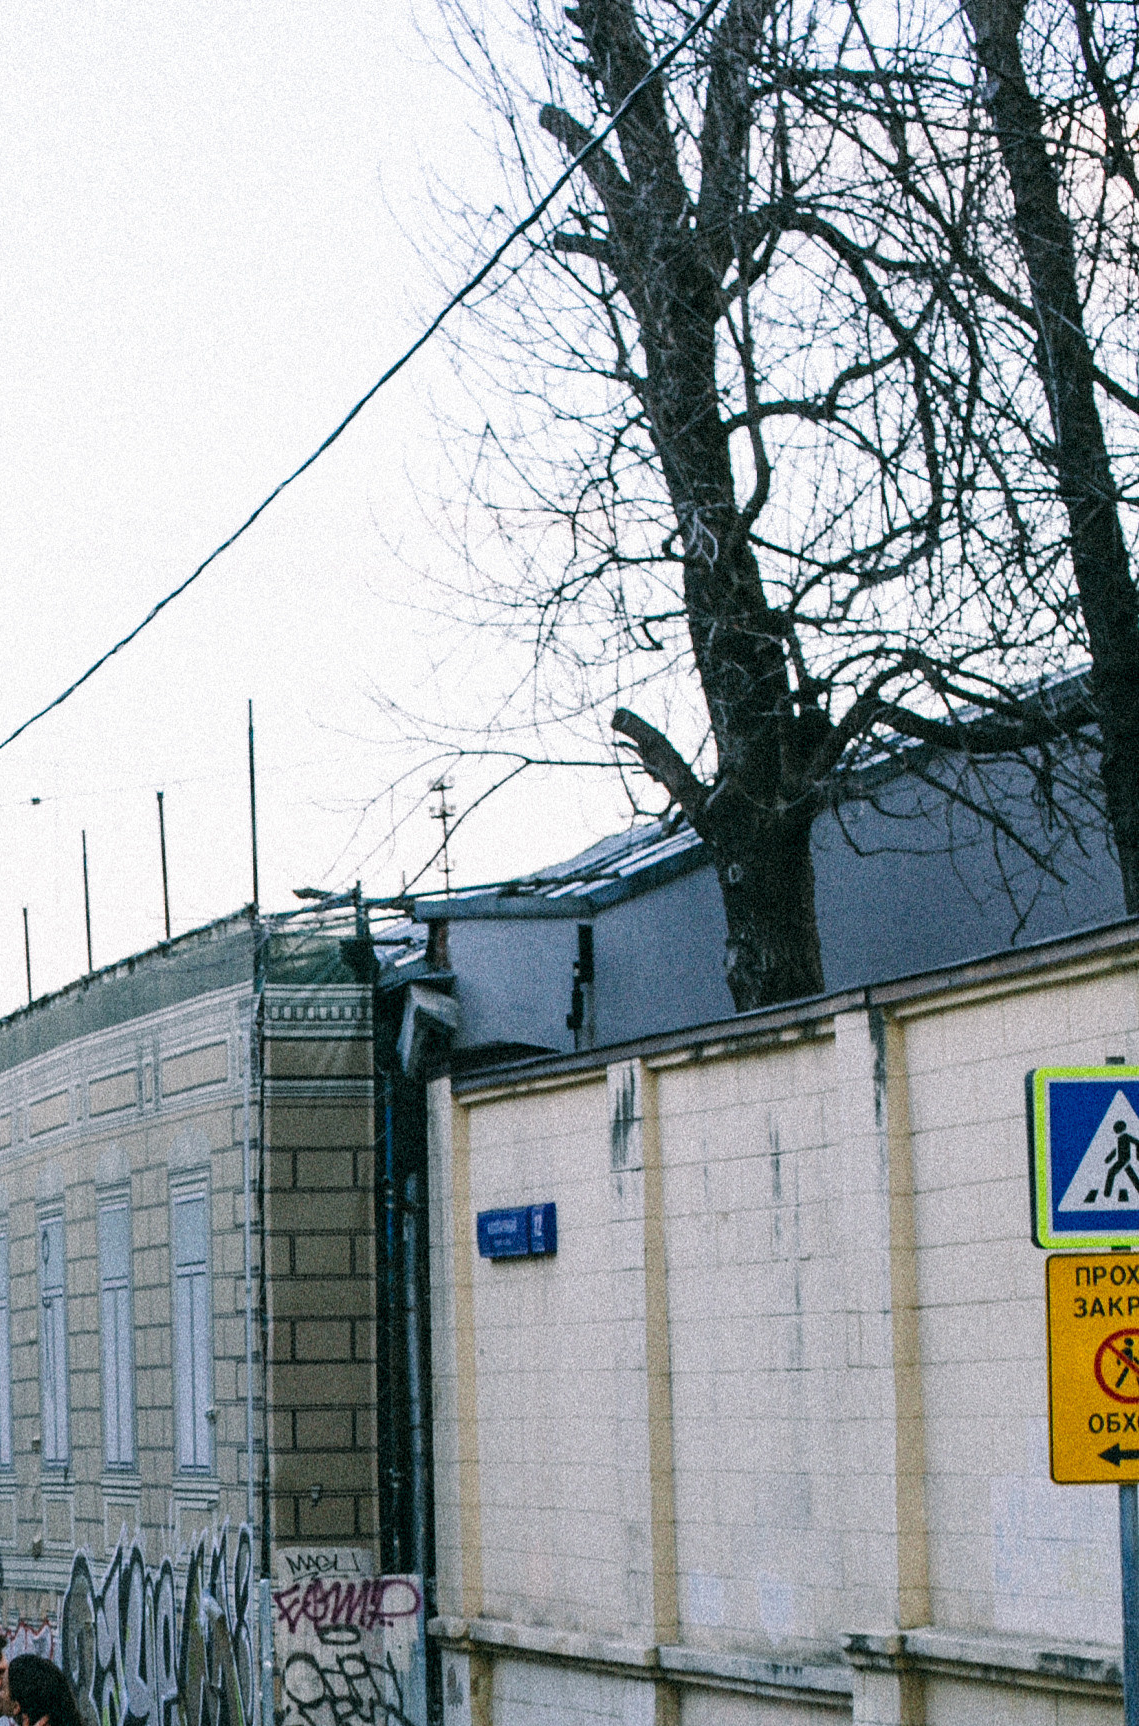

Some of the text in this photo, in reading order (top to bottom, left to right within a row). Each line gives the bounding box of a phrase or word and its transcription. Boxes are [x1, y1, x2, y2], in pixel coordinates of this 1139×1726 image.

[1075, 1265, 1139, 1287] ПРОХ
[1074, 1296, 1139, 1318] ЗАКР
[1089, 1412, 1139, 1434] ОБХ
